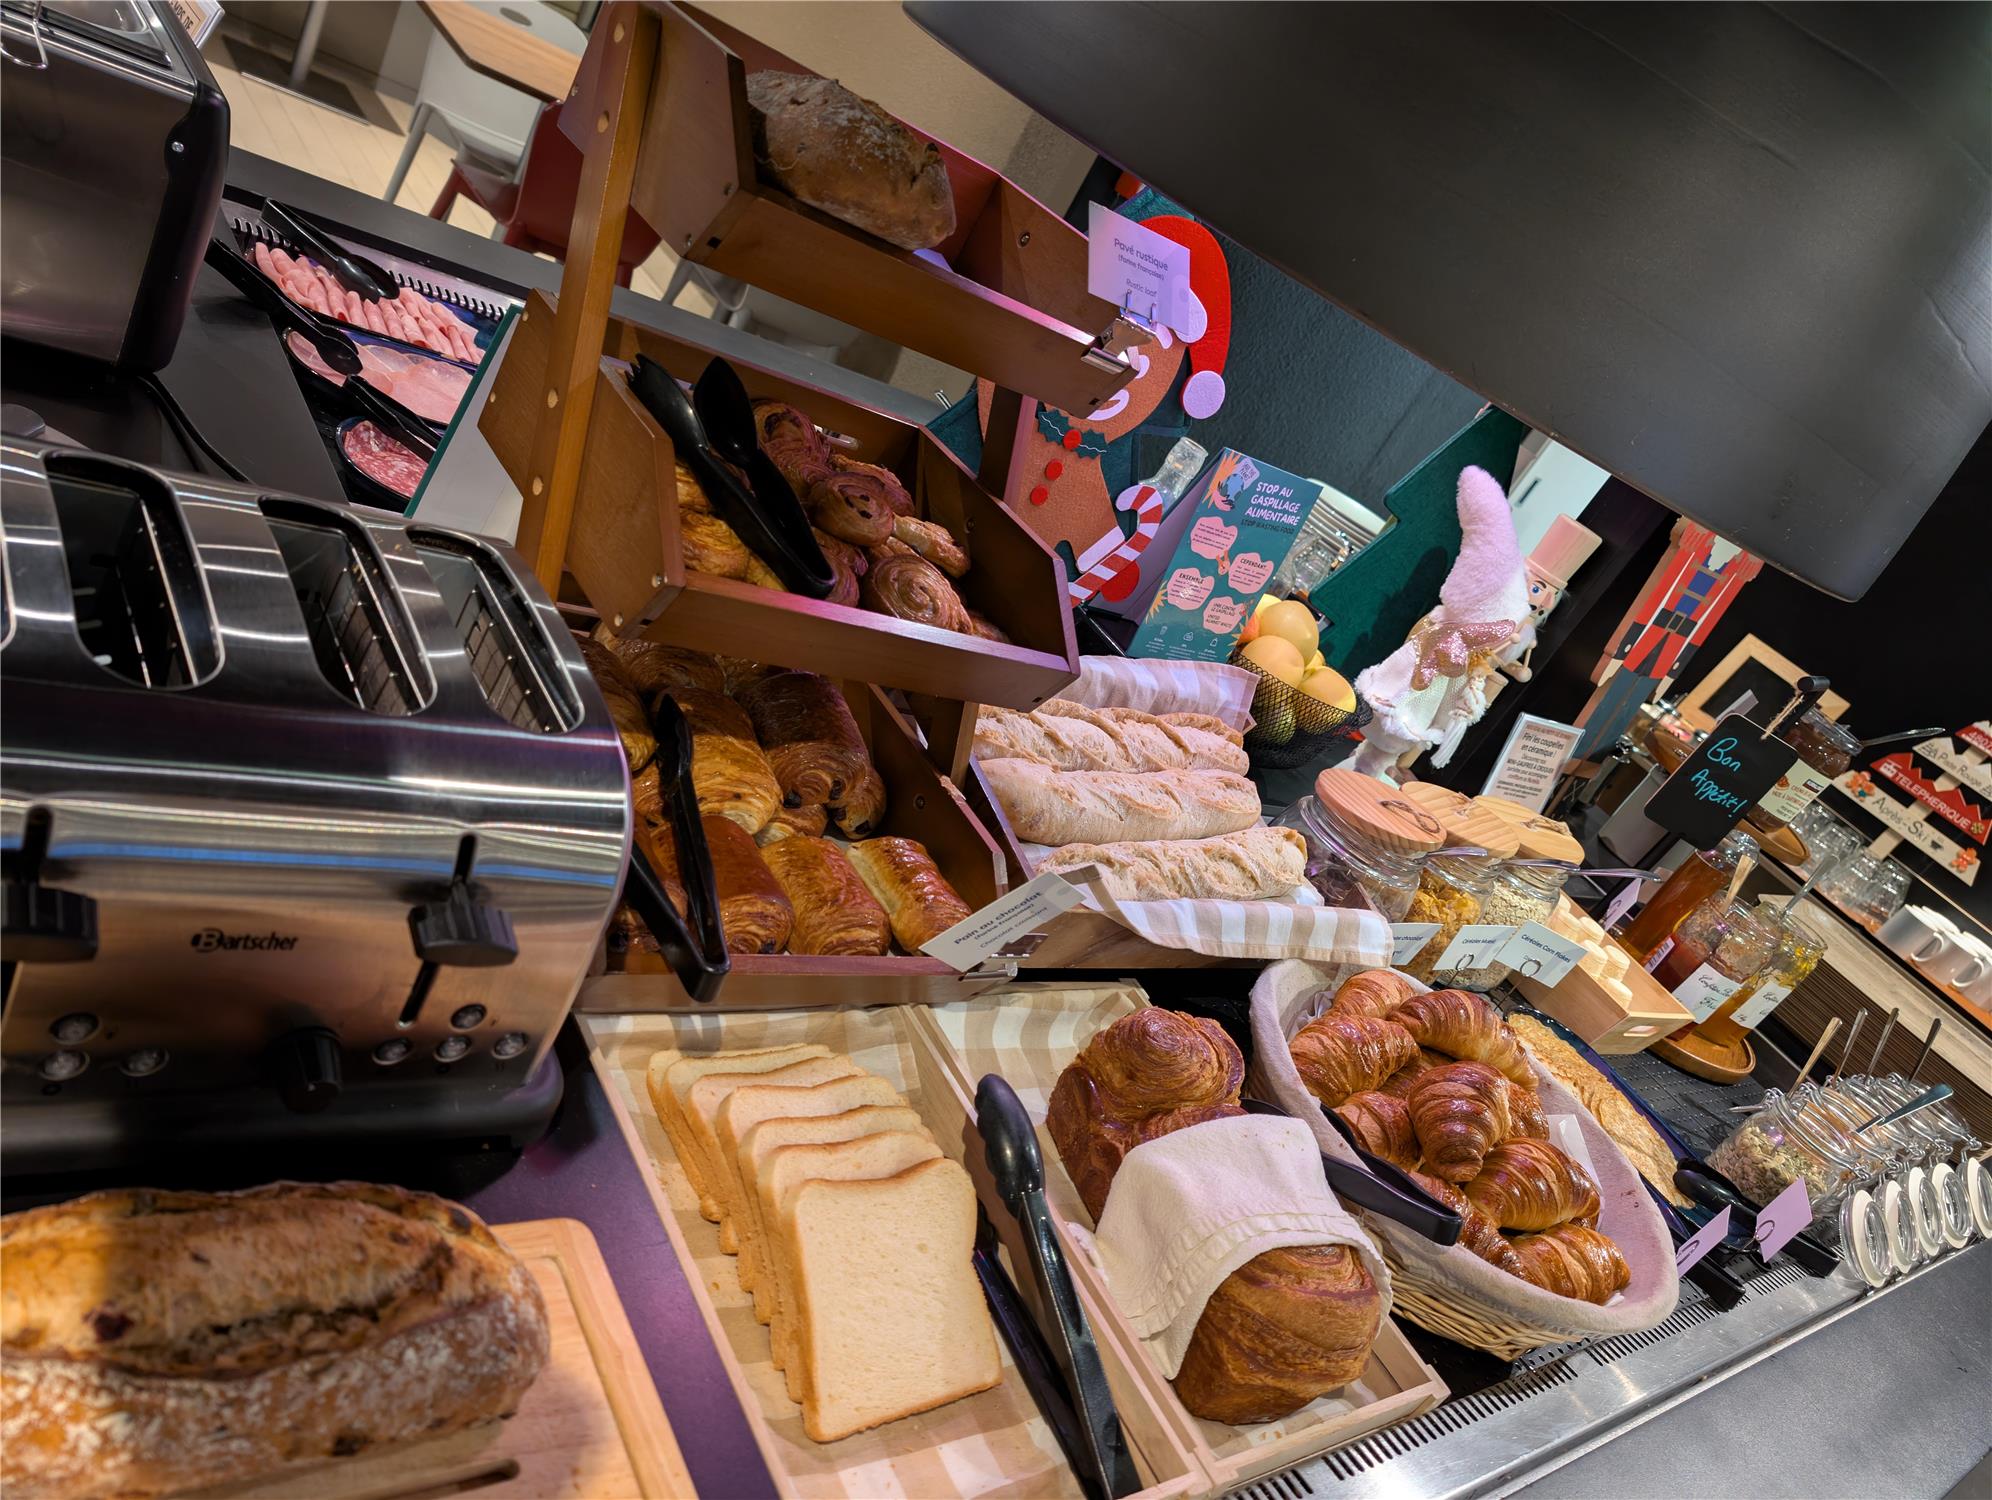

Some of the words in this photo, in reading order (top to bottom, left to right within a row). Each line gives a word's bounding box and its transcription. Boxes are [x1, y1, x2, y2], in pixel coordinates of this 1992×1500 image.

[1114, 238, 1135, 254] Pavé
[1136, 251, 1168, 271] rustique
[1256, 481, 1280, 495] STOP
[1278, 487, 1293, 498] AU
[1244, 506, 1301, 526] ALIMENTAIRE
[1250, 494, 1301, 513] GASPILLAGE
[1241, 519, 1257, 527] STOP
[1280, 526, 1295, 534] FOOD
[1707, 737, 1741, 773] Bon
[1894, 772, 1971, 829] TELEPHERIQUE
[954, 929, 979, 945] Pain
[979, 920, 994, 930] au
[995, 892, 1042, 921] chocolat
[190, 927, 299, 953] Bartscher
[1521, 934, 1543, 948] Céréales
[1542, 945, 1556, 954] Corn
[1555, 951, 1571, 963] Flakes
